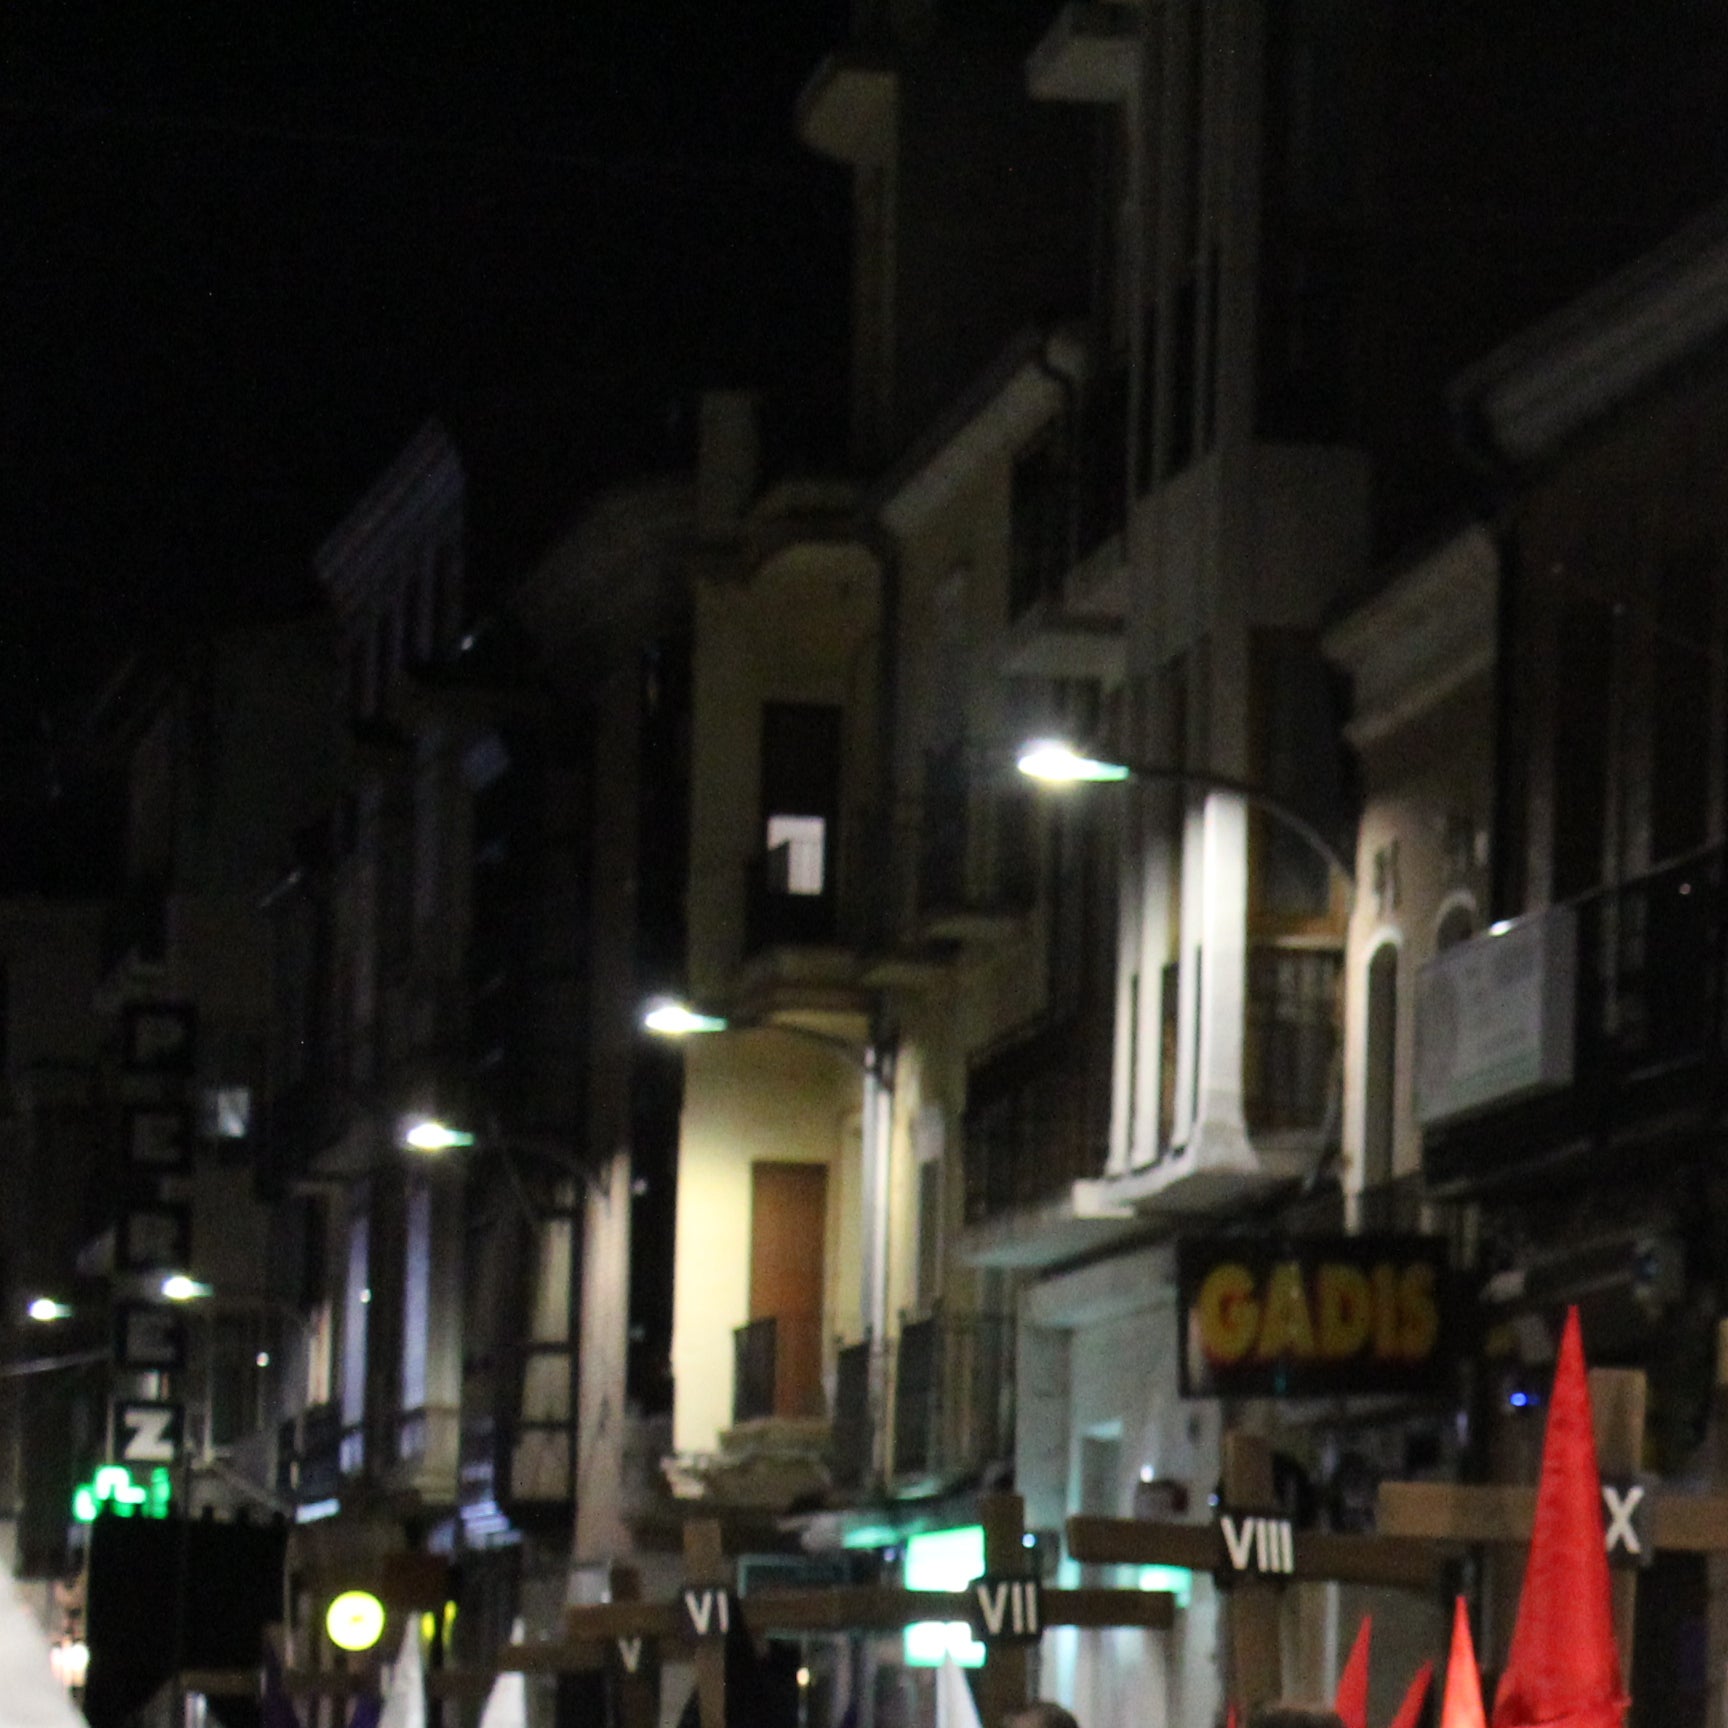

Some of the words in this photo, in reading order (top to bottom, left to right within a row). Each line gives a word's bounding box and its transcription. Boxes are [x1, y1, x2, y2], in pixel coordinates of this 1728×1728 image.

[1200, 1261, 1438, 1364] GADIS
[1221, 1514, 1294, 1574] VIII
[685, 1588, 730, 1636] VI
[977, 1580, 1038, 1635] VII
[617, 1636, 643, 1674] V
